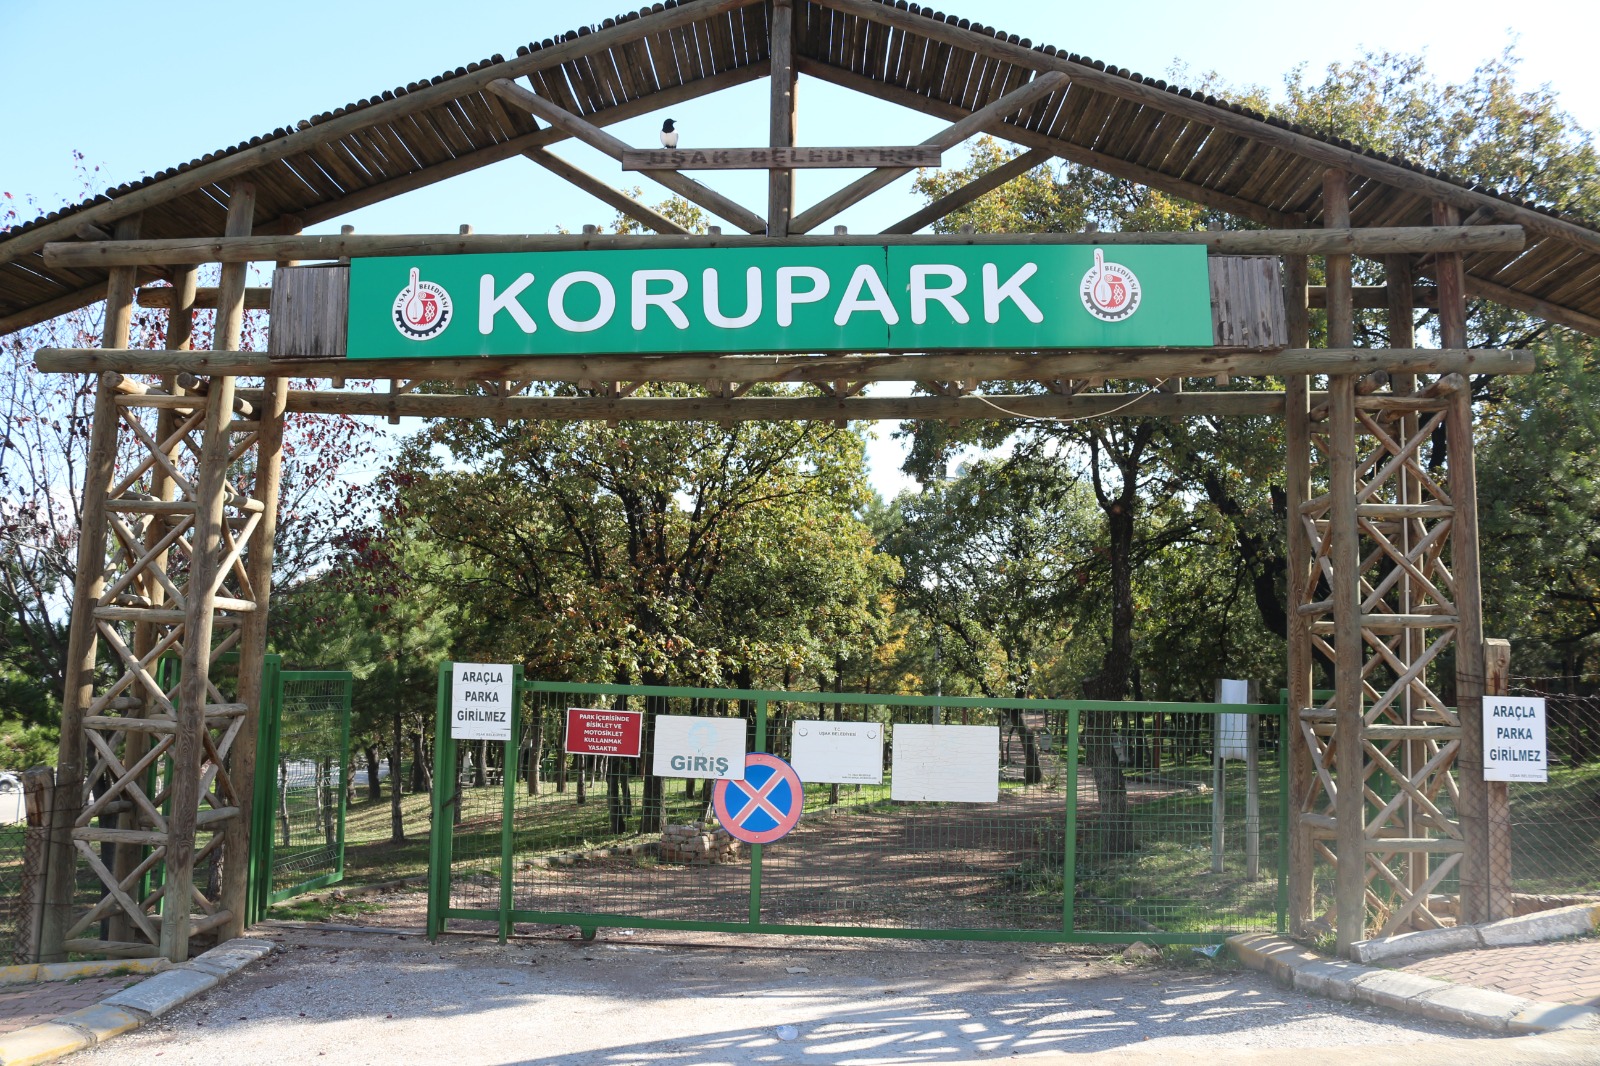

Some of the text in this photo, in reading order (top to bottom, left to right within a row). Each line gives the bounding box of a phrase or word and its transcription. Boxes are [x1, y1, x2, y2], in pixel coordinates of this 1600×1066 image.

[1104, 265, 1138, 290] BELEDİYESİ
[419, 283, 449, 308] BELEDİYESİ
[478, 262, 1044, 335] KORUPARK
[462, 671, 503, 685] ARAÇLA
[465, 691, 499, 702] PARKA
[457, 708, 506, 722] GİRİLMEZ
[596, 714, 630, 722] İÇERİSİNDE
[1493, 705, 1536, 721] ARAÇLA
[584, 729, 623, 737] MOTOSİKLET
[1497, 727, 1533, 739] PARKA
[1490, 747, 1541, 762] GİRİLMEZ
